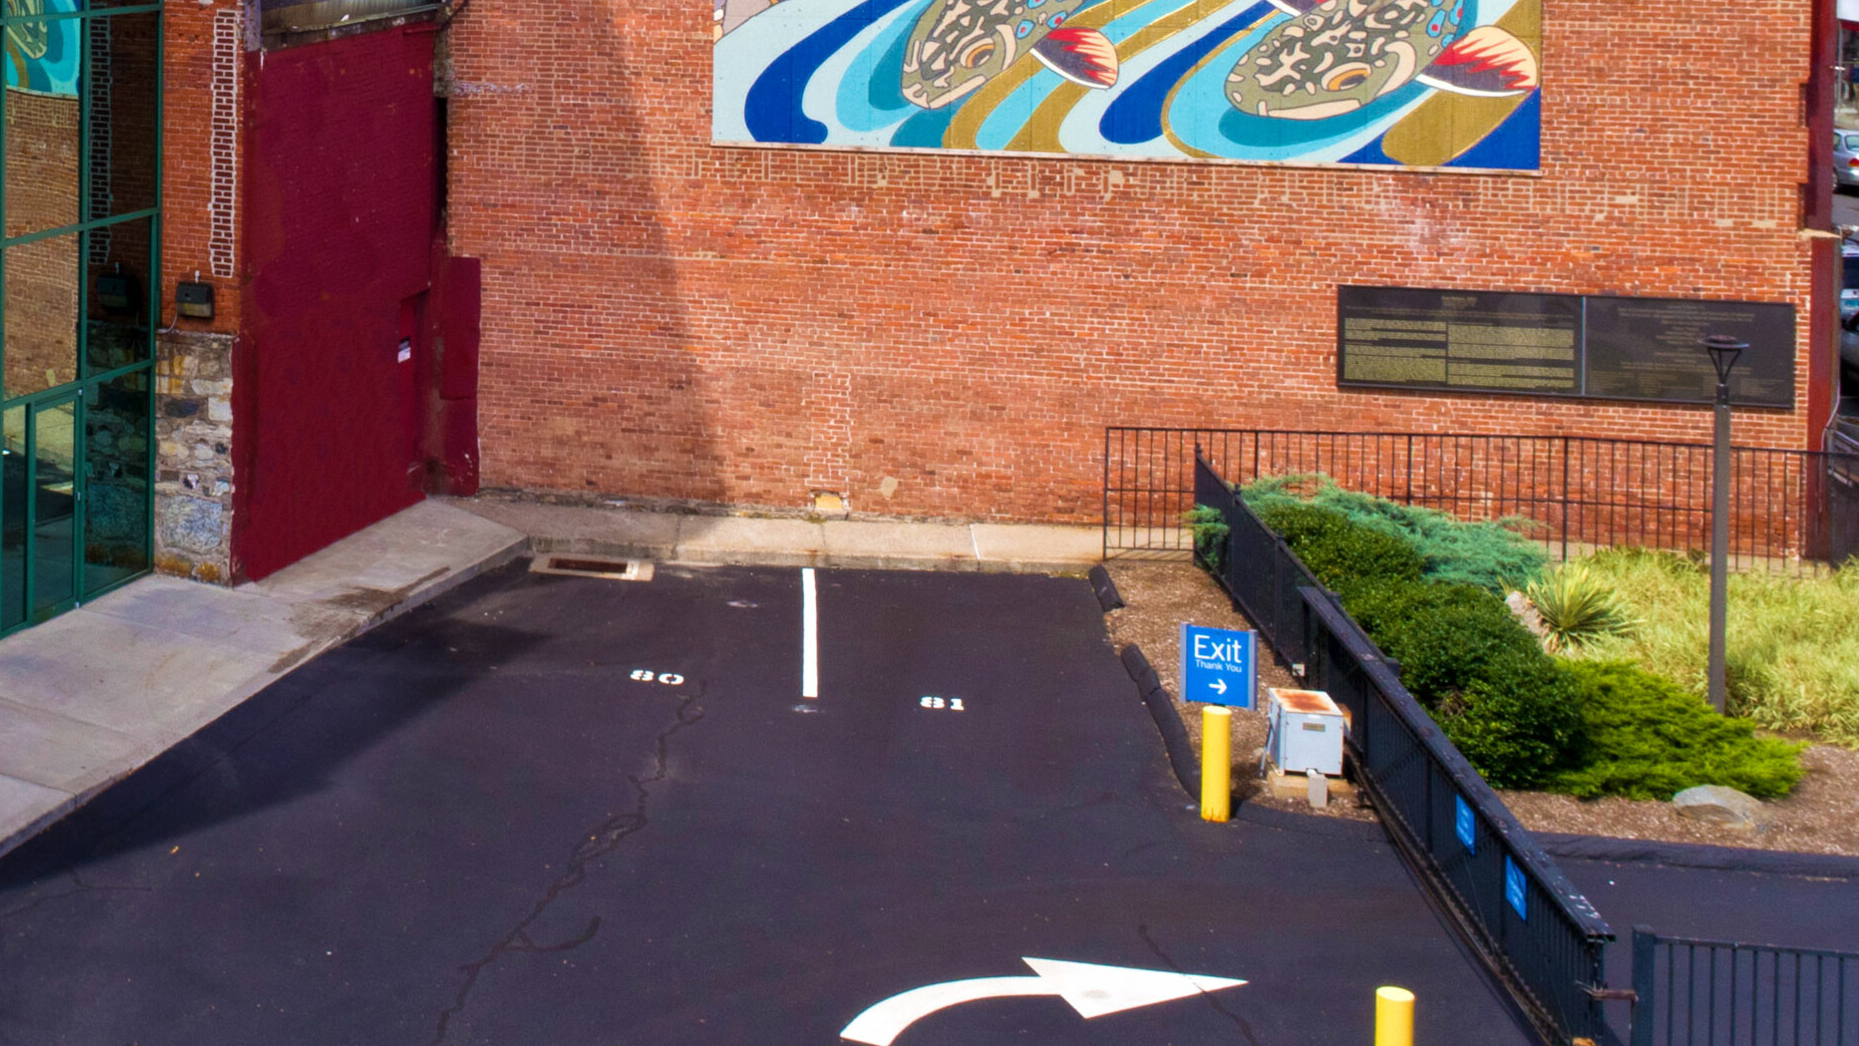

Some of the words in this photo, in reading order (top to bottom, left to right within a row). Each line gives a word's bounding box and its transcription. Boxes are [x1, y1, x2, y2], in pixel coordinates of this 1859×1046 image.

[1194, 634, 1242, 663] Exit
[1196, 659, 1223, 671] Thank
[1225, 663, 1242, 673] You
[630, 669, 684, 685] 80
[920, 696, 964, 711] 81
